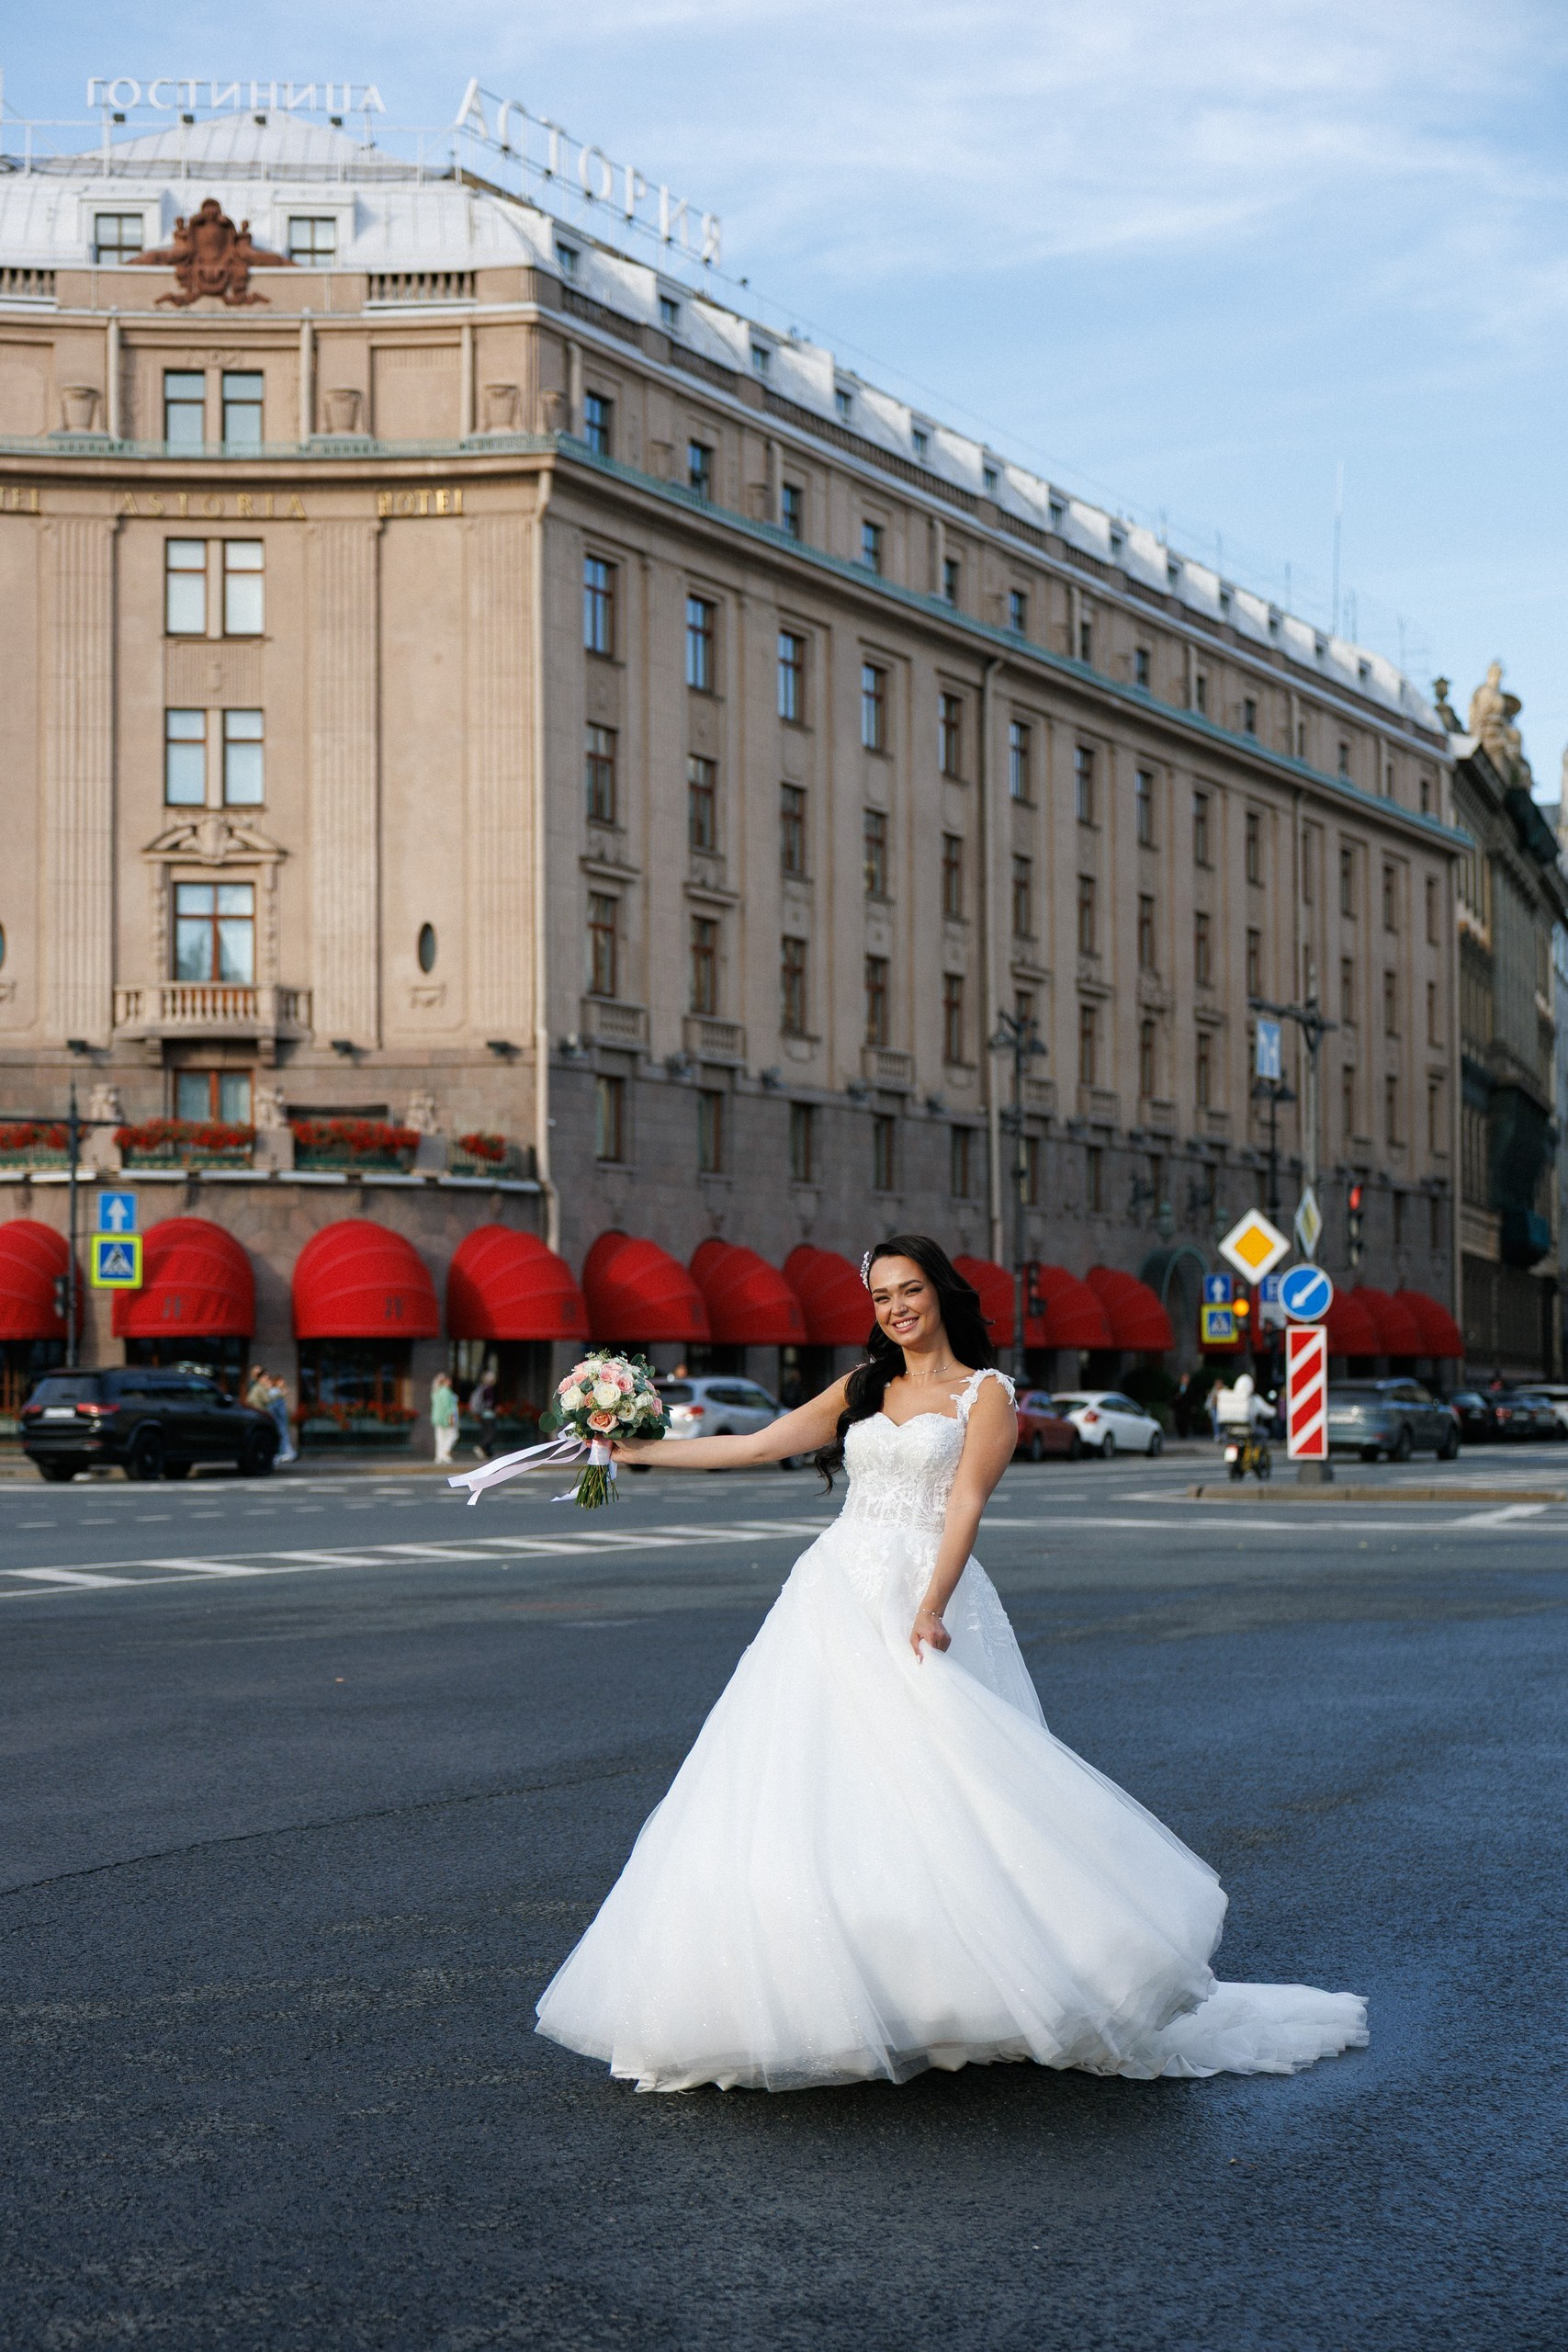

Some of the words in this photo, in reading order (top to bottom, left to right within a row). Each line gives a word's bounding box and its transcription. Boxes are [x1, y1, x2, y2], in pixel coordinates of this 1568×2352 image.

[86, 77, 387, 114] ГОСТИНИЦА
[455, 77, 720, 269] АСТОРИЯ
[120, 492, 307, 518] ASTORIA
[378, 488, 463, 516] HOTEL
